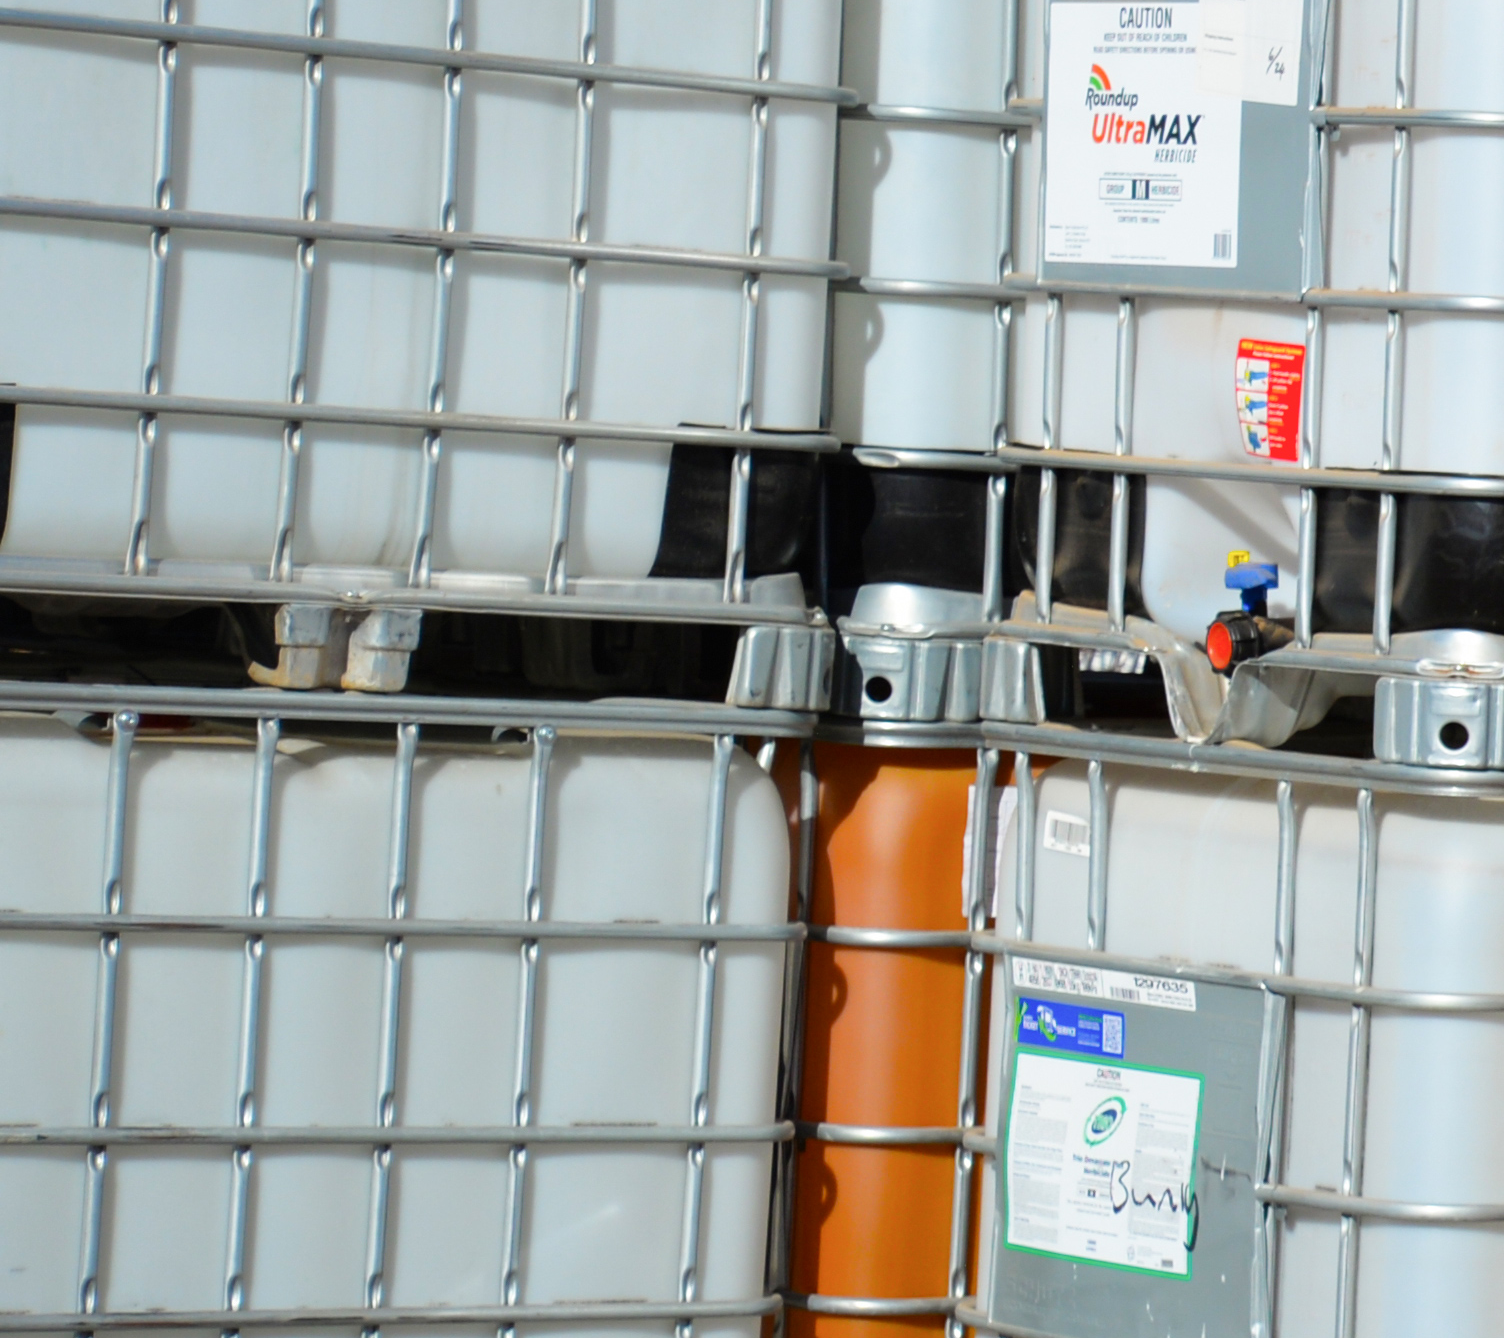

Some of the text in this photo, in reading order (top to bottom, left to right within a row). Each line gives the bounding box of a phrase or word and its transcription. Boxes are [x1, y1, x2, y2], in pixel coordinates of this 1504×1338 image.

[1120, 7, 1173, 28] CAUTION
[1162, 33, 1187, 42] CHILDREN
[1085, 87, 1139, 111] Roundup
[1092, 113, 1202, 145] UltraMAX
[1154, 149, 1197, 163] HERBICIDE
[1106, 184, 1124, 194] GROUP
[1151, 186, 1180, 196] HERBICIDE
[1133, 976, 1188, 994] 1297635
